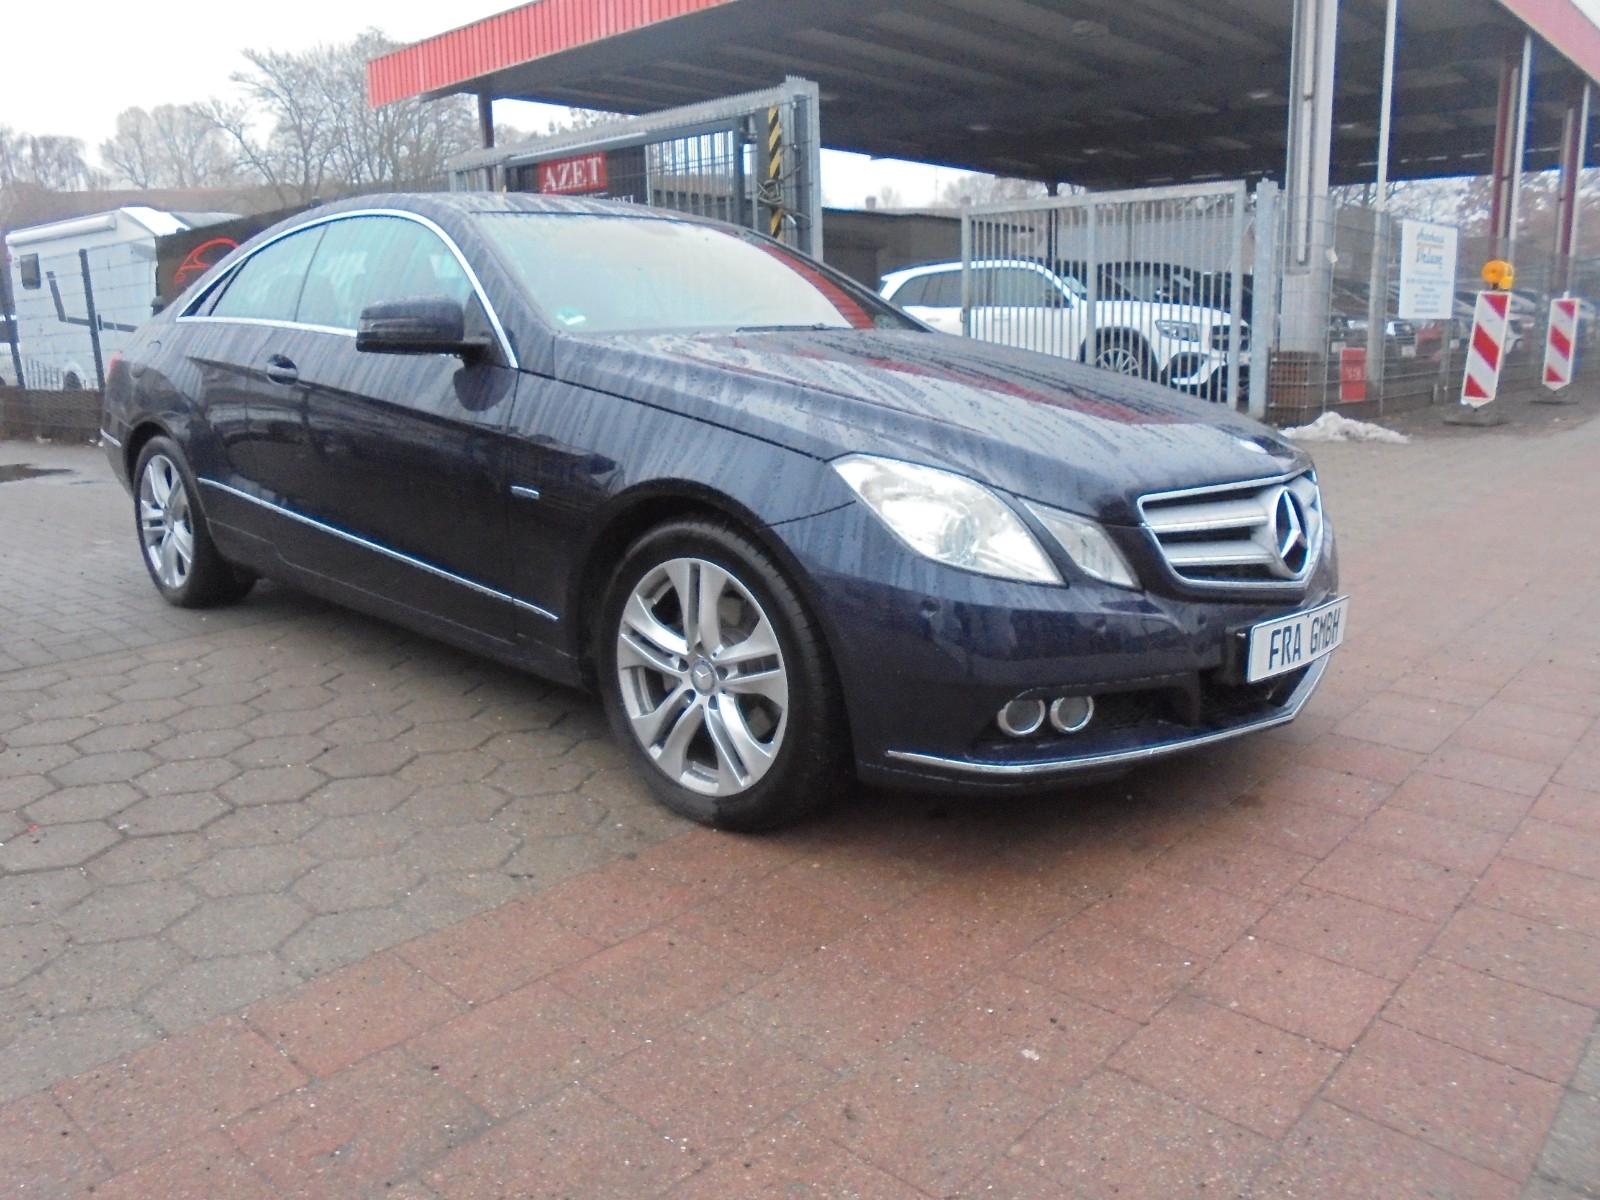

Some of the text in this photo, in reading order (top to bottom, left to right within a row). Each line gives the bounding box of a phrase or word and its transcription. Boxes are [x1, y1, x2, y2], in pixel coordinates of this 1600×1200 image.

[543, 156, 602, 193] AZET
[1268, 607, 1342, 671] FRA GMBH
